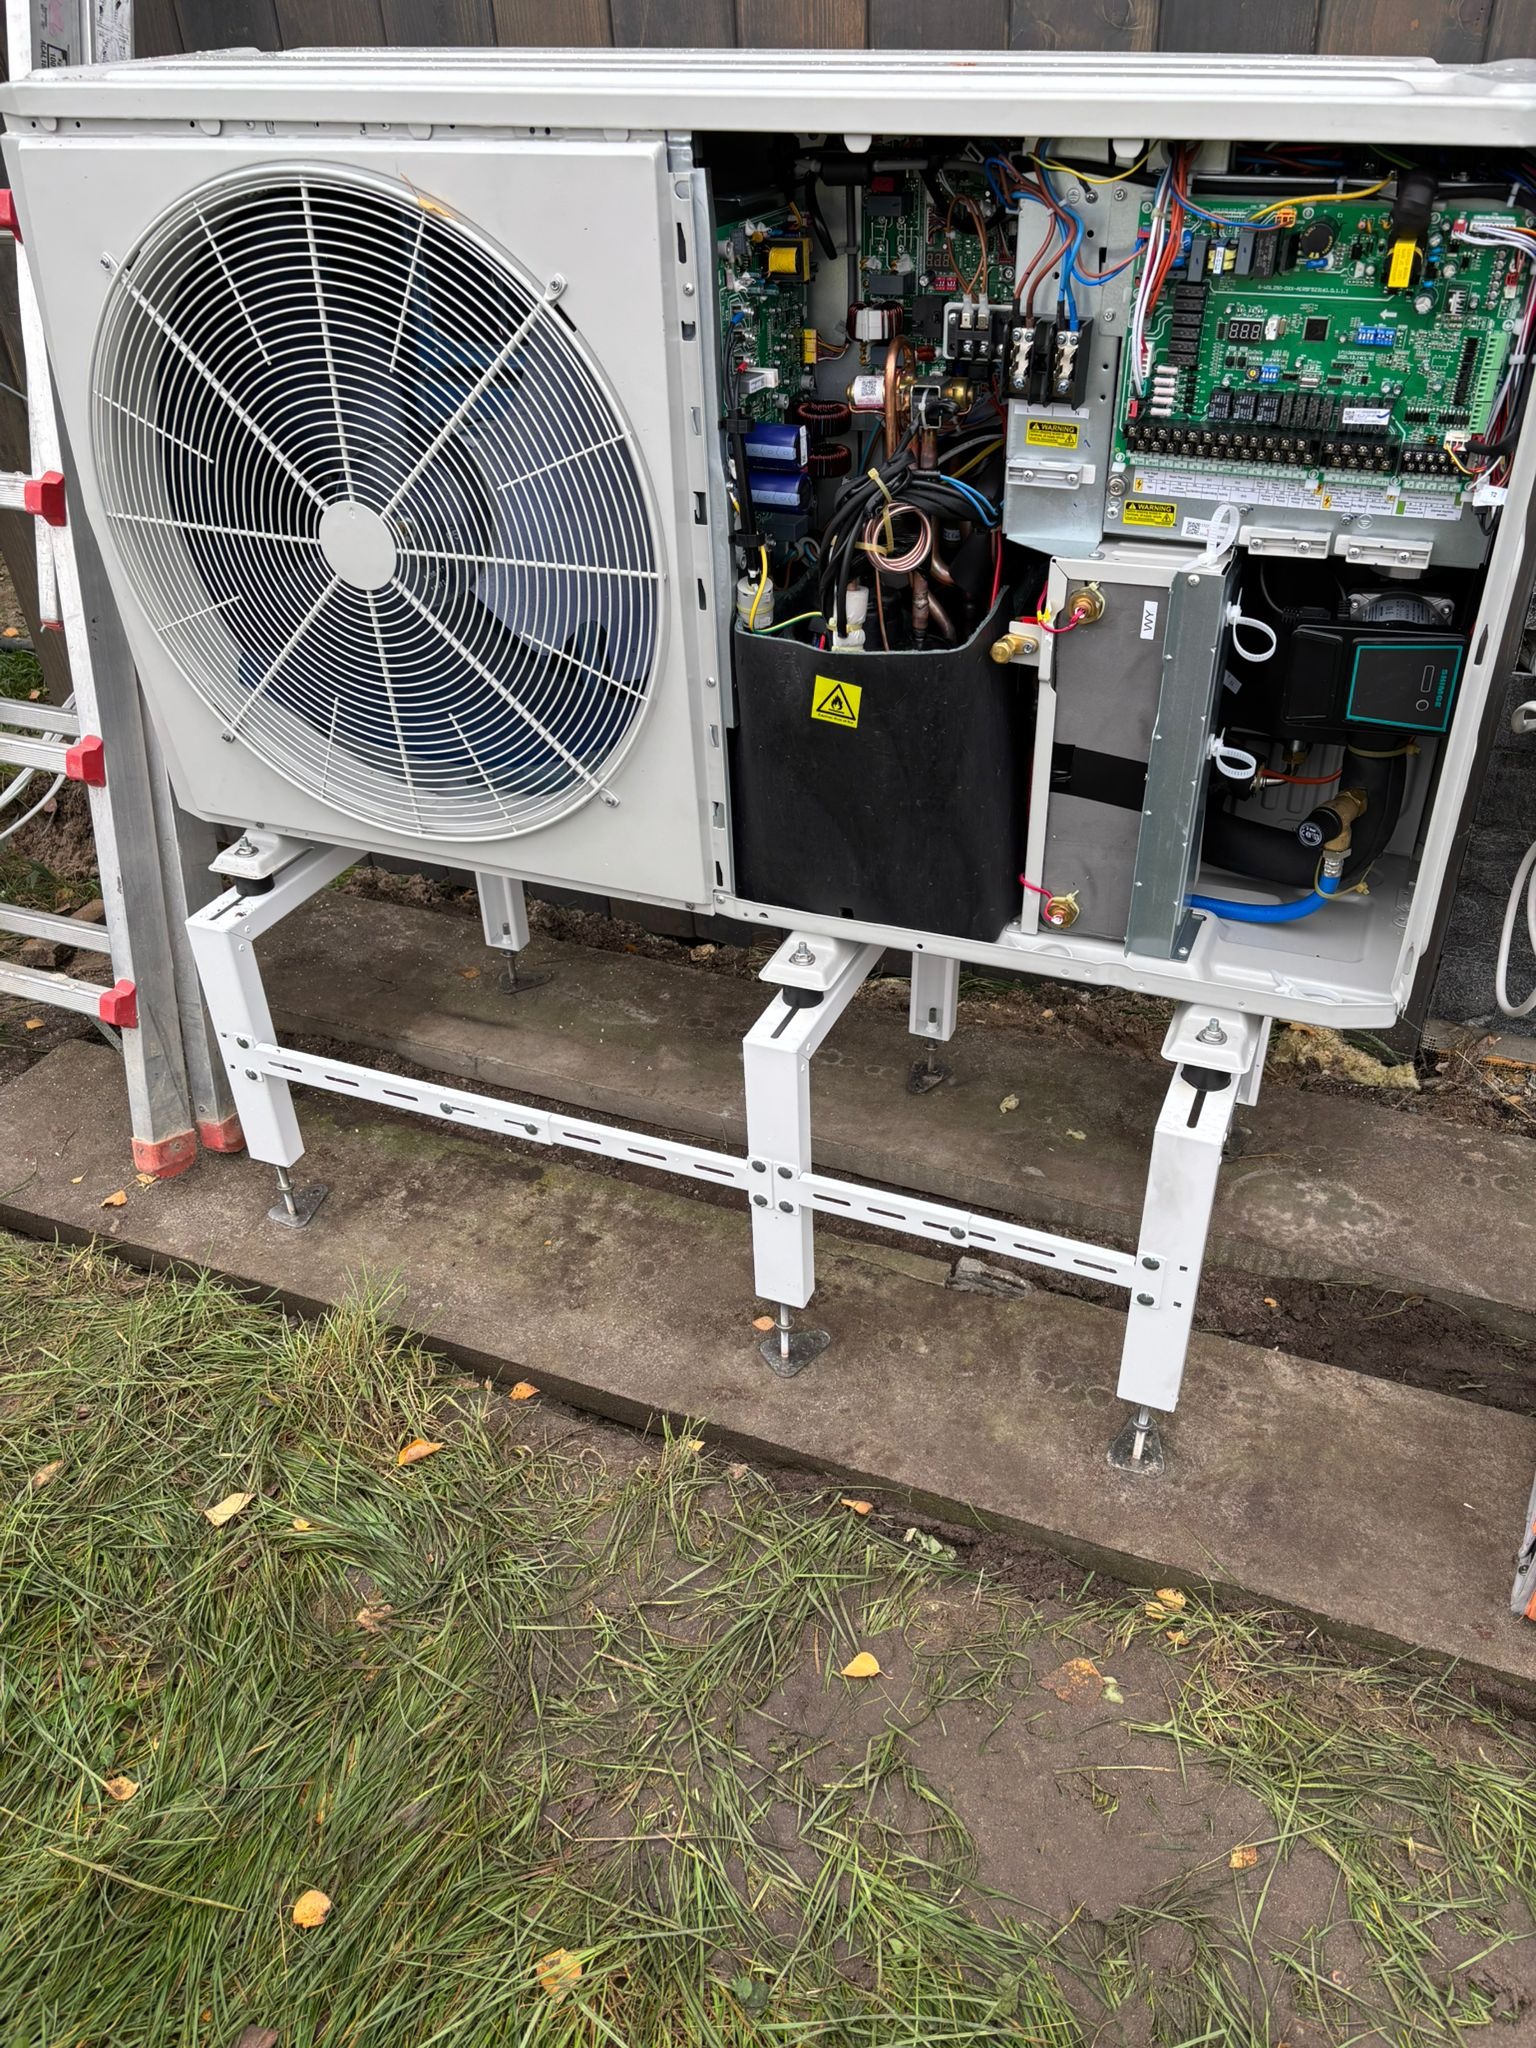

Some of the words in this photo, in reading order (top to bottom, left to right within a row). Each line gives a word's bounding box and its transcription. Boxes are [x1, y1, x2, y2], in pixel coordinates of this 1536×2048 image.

[1041, 423, 1075, 433] WARNING
[1137, 503, 1172, 513] WARNING
[1143, 609, 1155, 631] WY
[1434, 669, 1448, 708] SHIMGE
